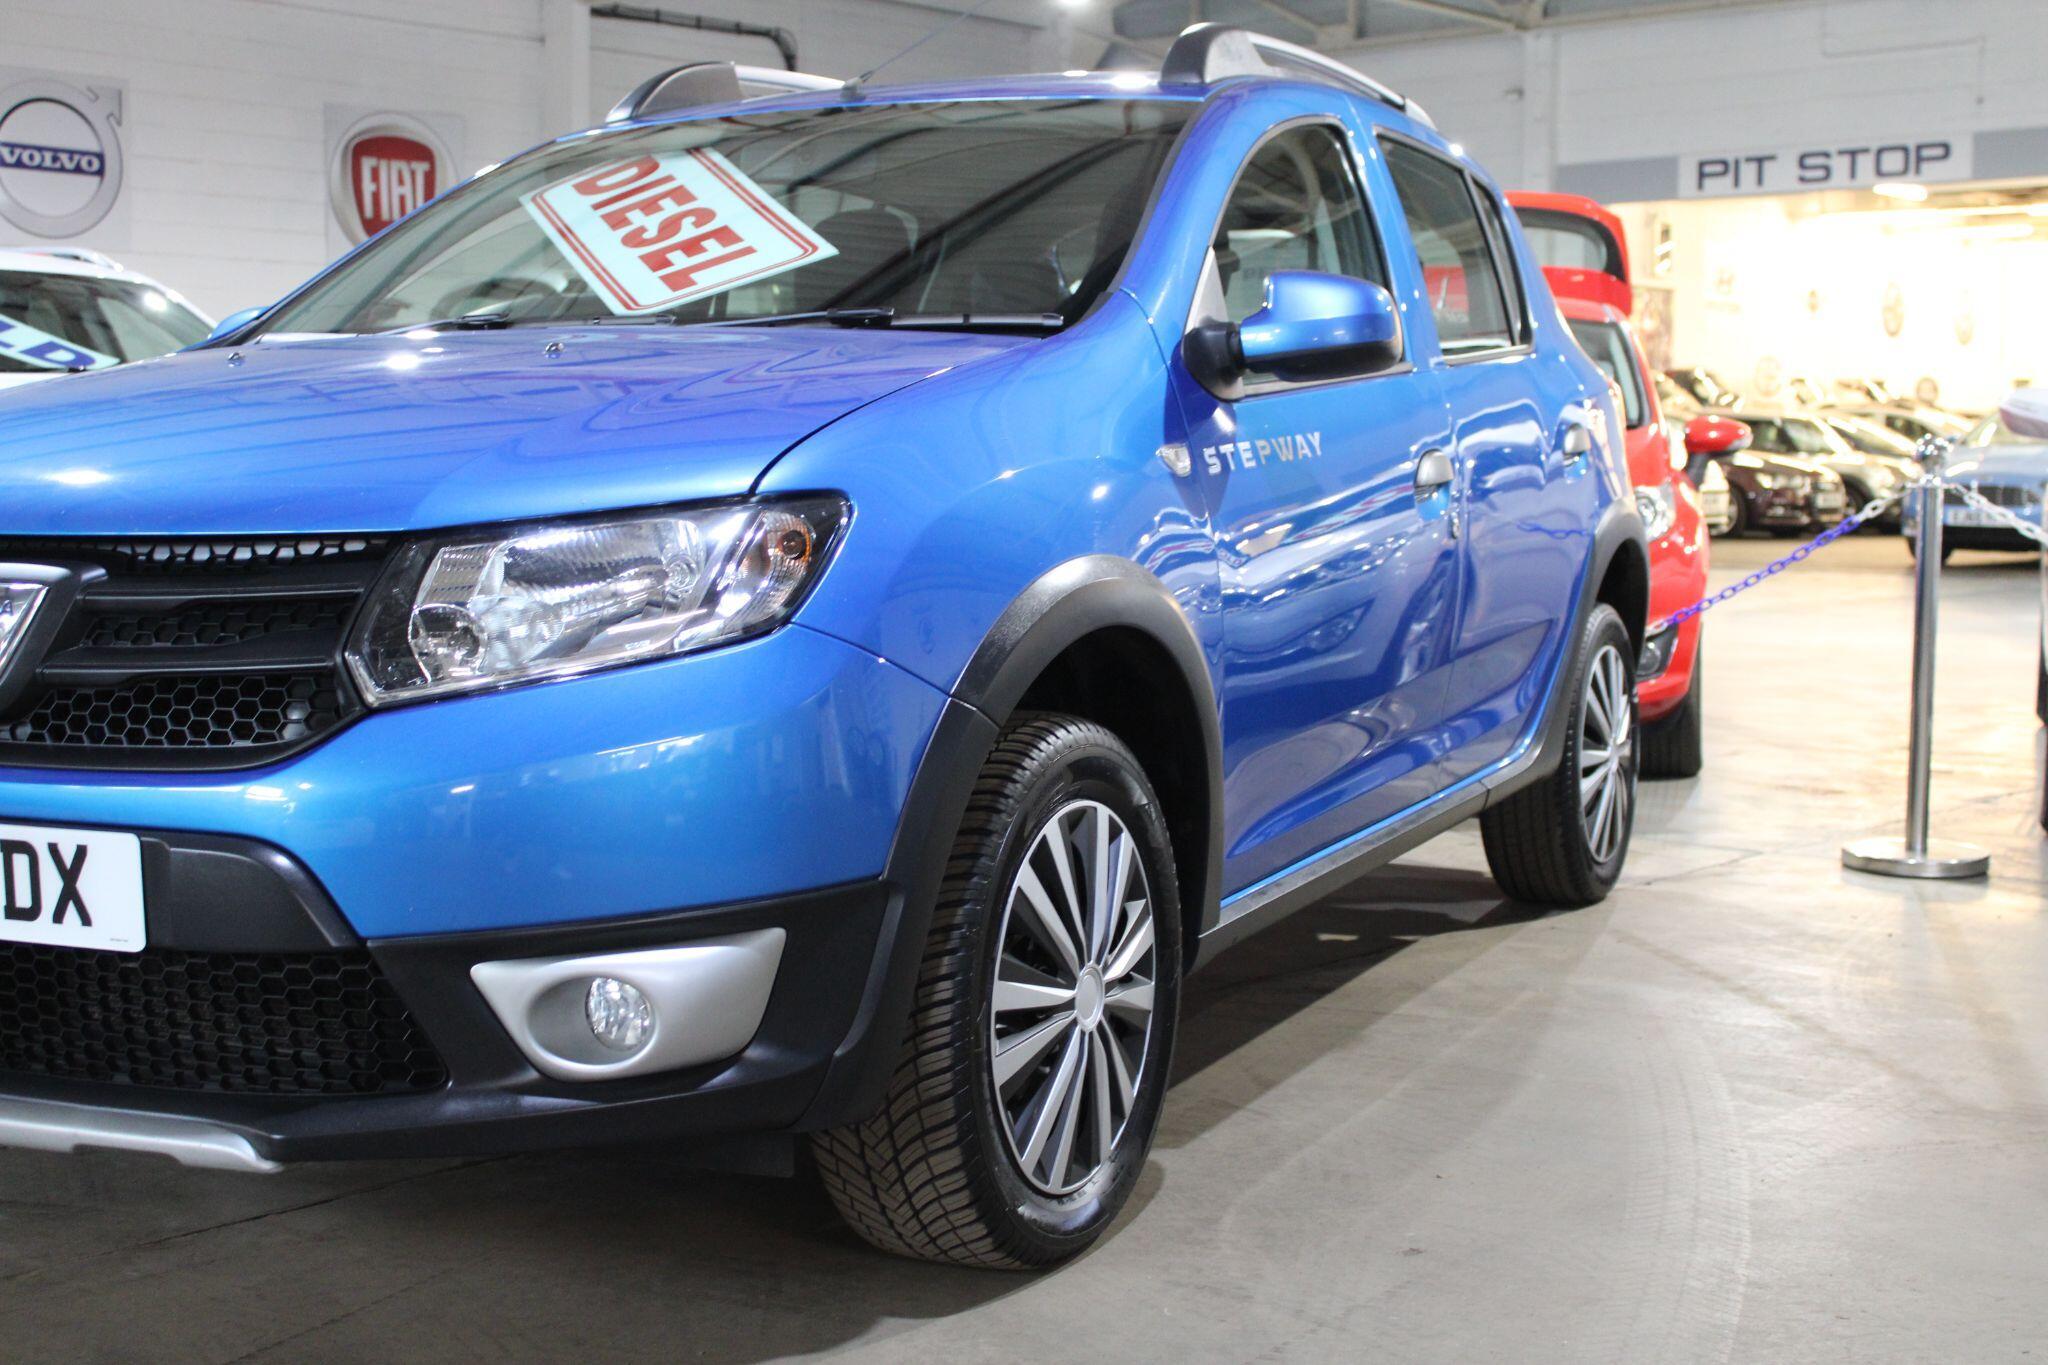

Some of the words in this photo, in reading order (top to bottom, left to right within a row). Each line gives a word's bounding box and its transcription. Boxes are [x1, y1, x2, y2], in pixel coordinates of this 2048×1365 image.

[0, 147, 101, 172] VOLVO
[1698, 154, 1777, 191] PIT
[1799, 142, 1951, 184] STOP
[361, 156, 430, 222] FIAT
[571, 153, 758, 293] DIESEL
[1203, 431, 1322, 476] STEPWAY
[0, 838, 93, 928] DX
